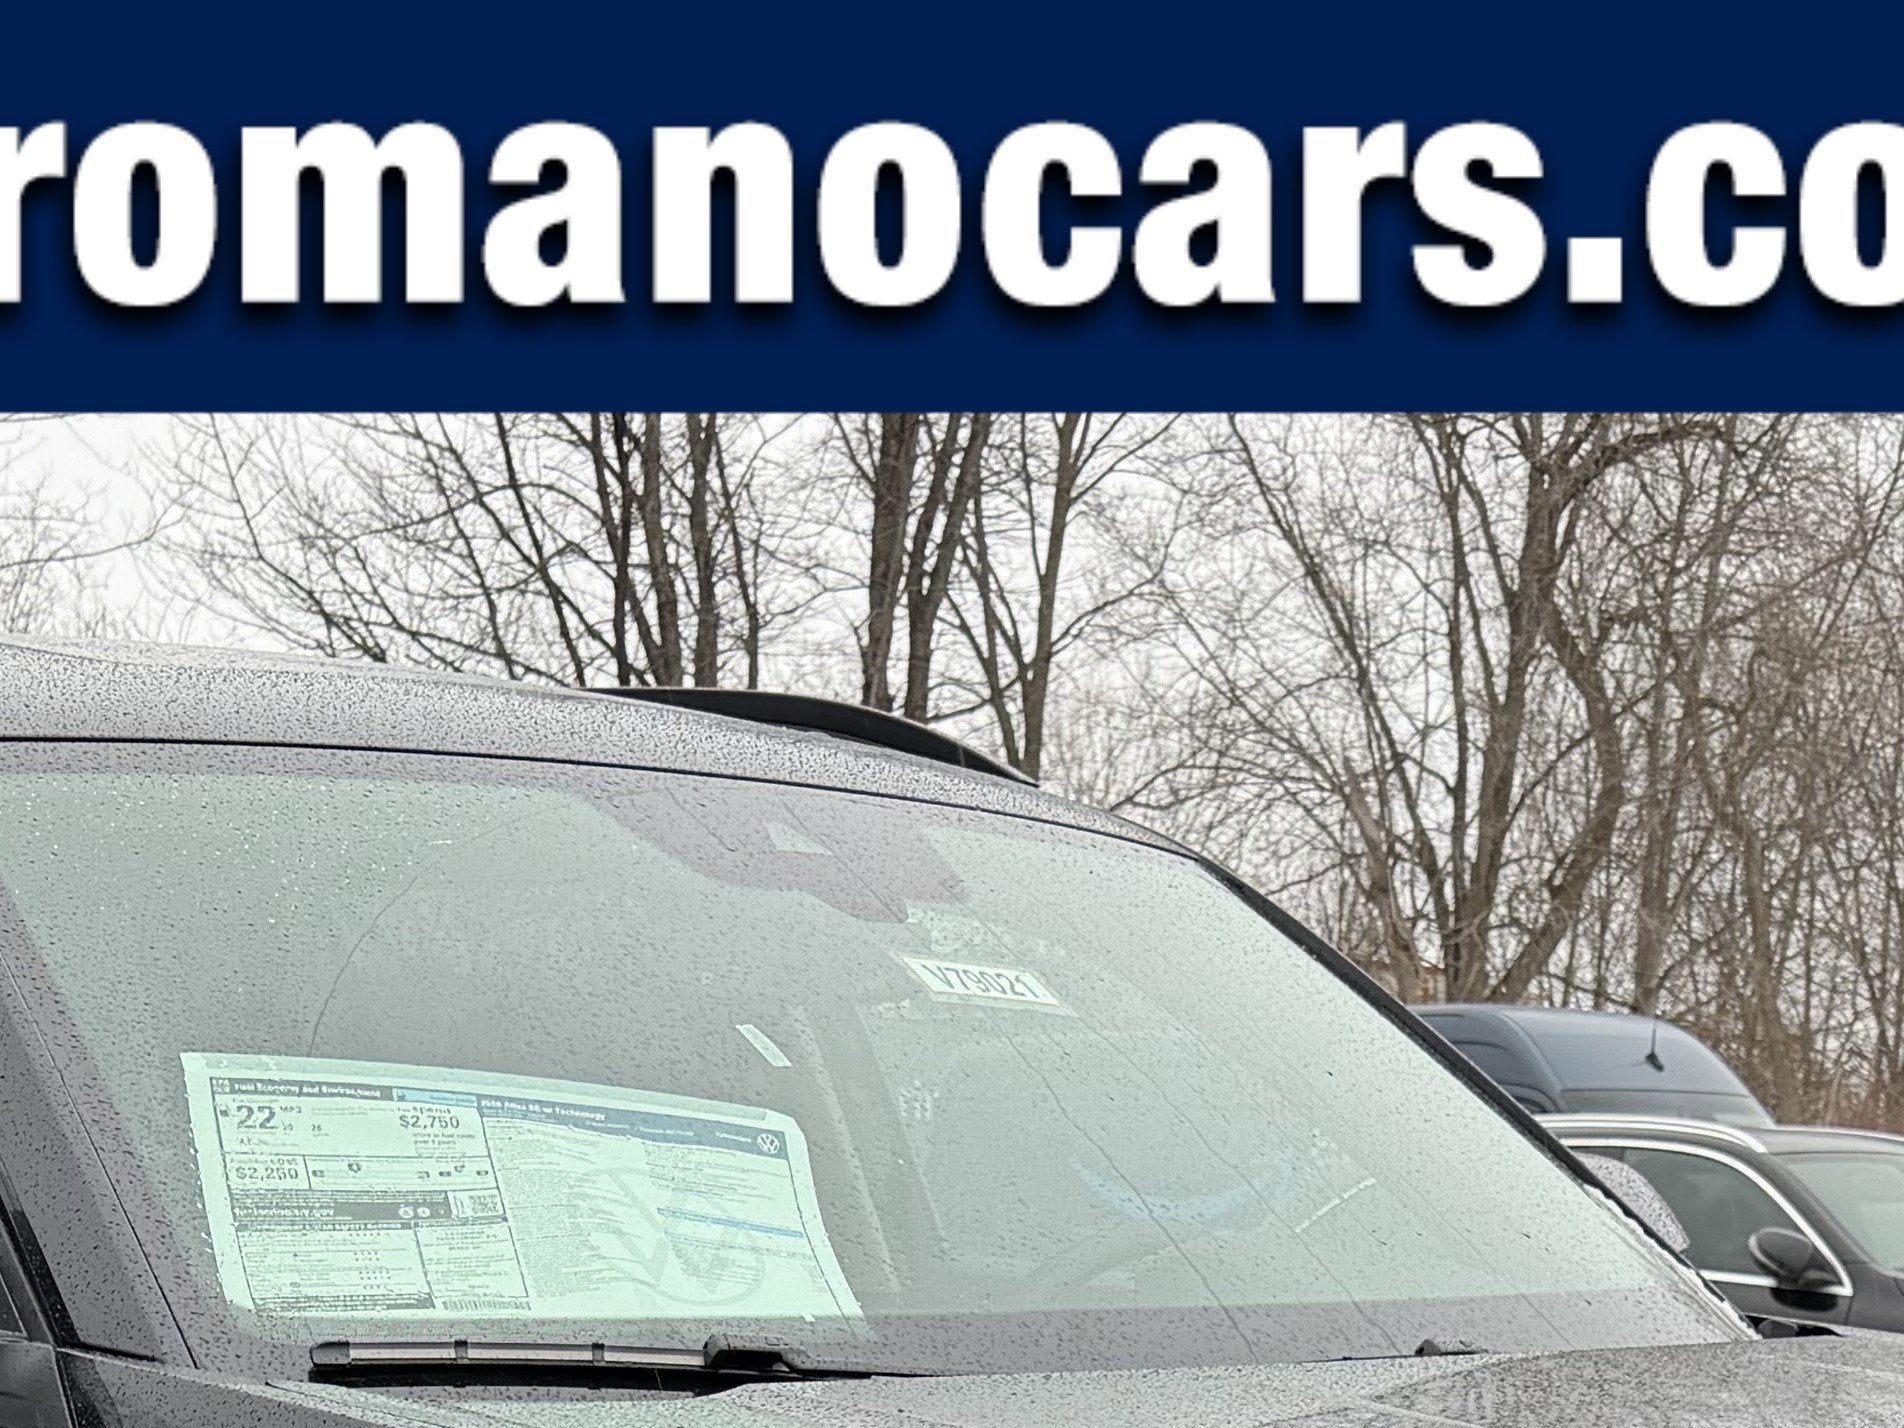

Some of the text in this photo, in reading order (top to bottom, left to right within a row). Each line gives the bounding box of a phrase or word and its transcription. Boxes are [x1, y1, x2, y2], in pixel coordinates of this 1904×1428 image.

[921, 964, 1040, 998] V79021
[236, 1104, 279, 1129] 22
[398, 1113, 461, 1130] $2,750
